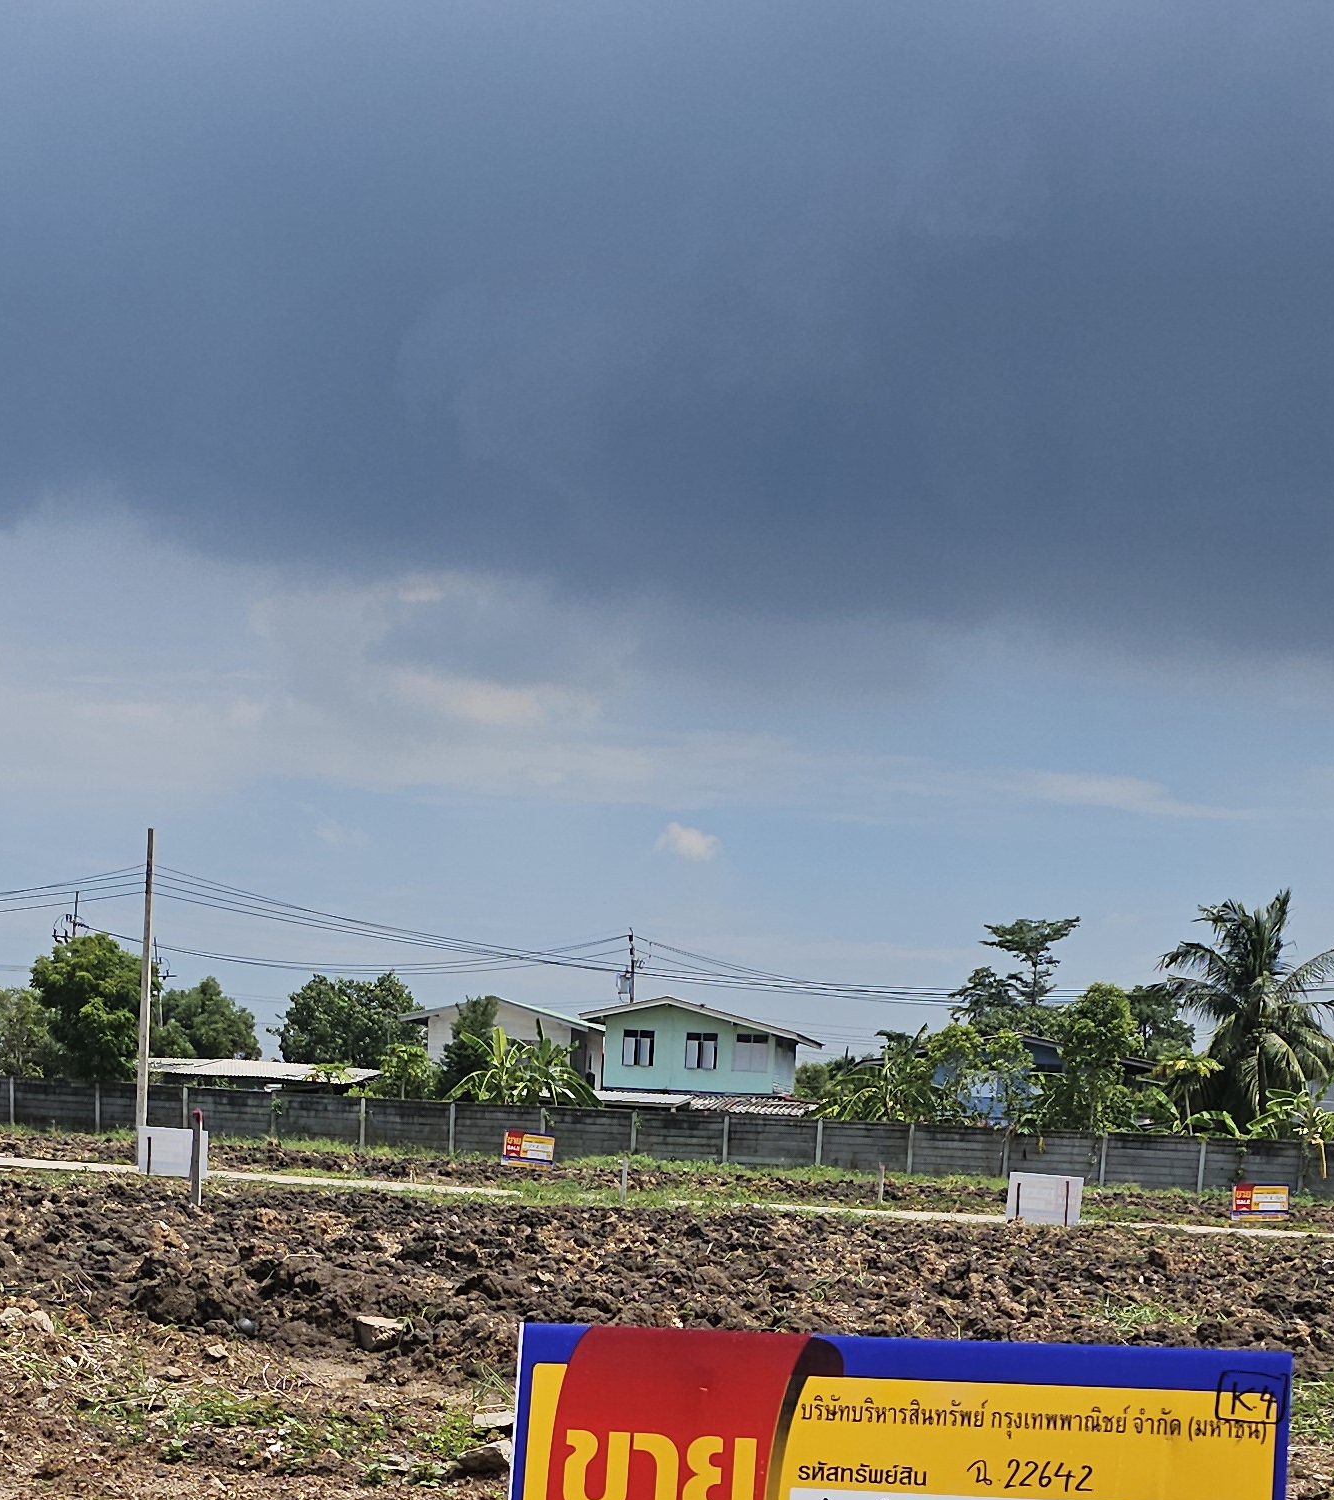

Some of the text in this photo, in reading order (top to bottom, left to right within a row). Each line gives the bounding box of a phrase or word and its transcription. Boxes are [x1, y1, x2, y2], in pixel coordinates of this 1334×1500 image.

[1132, 1408, 1182, 1437] จำกัด
[797, 1461, 927, 1487] รหัสทรัพย์สิน
